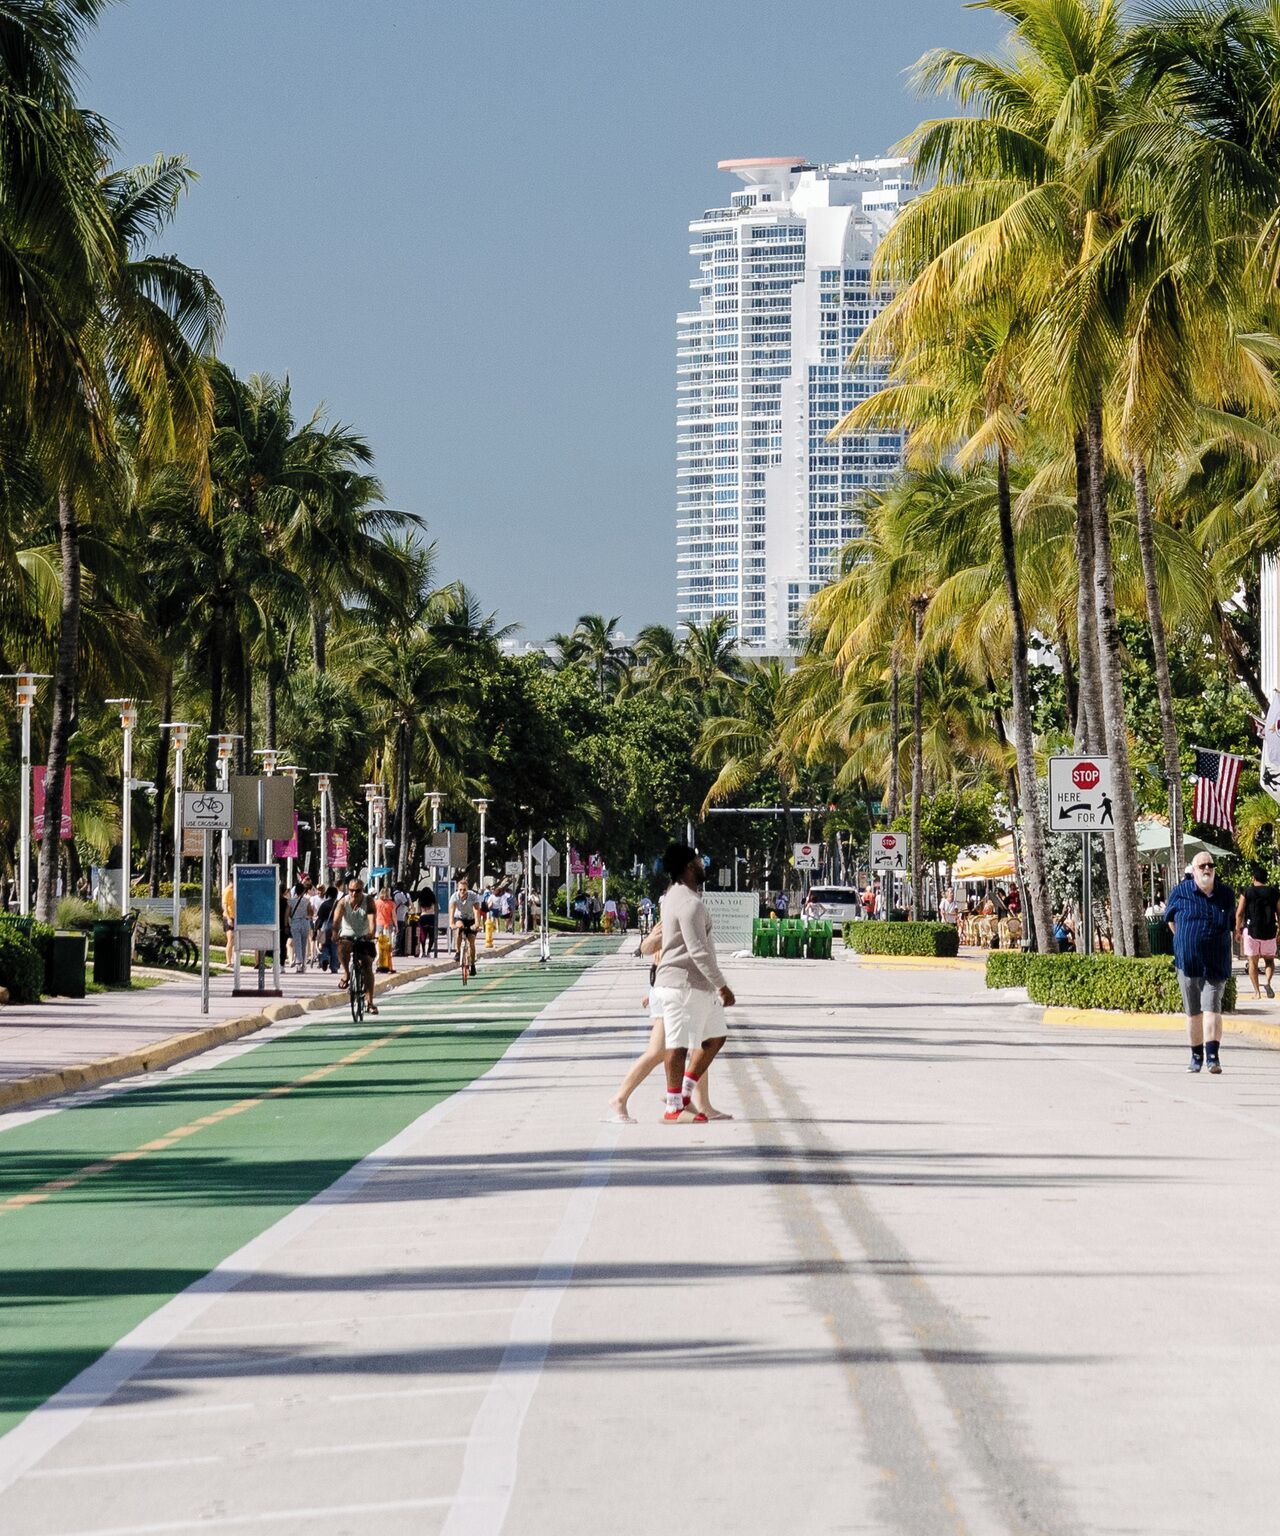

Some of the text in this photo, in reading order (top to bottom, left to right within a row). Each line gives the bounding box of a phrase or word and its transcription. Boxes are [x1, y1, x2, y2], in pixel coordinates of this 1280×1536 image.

[1073, 770, 1099, 782] STOP
[1057, 792, 1081, 802] HERE
[1077, 813, 1096, 823] FOR
